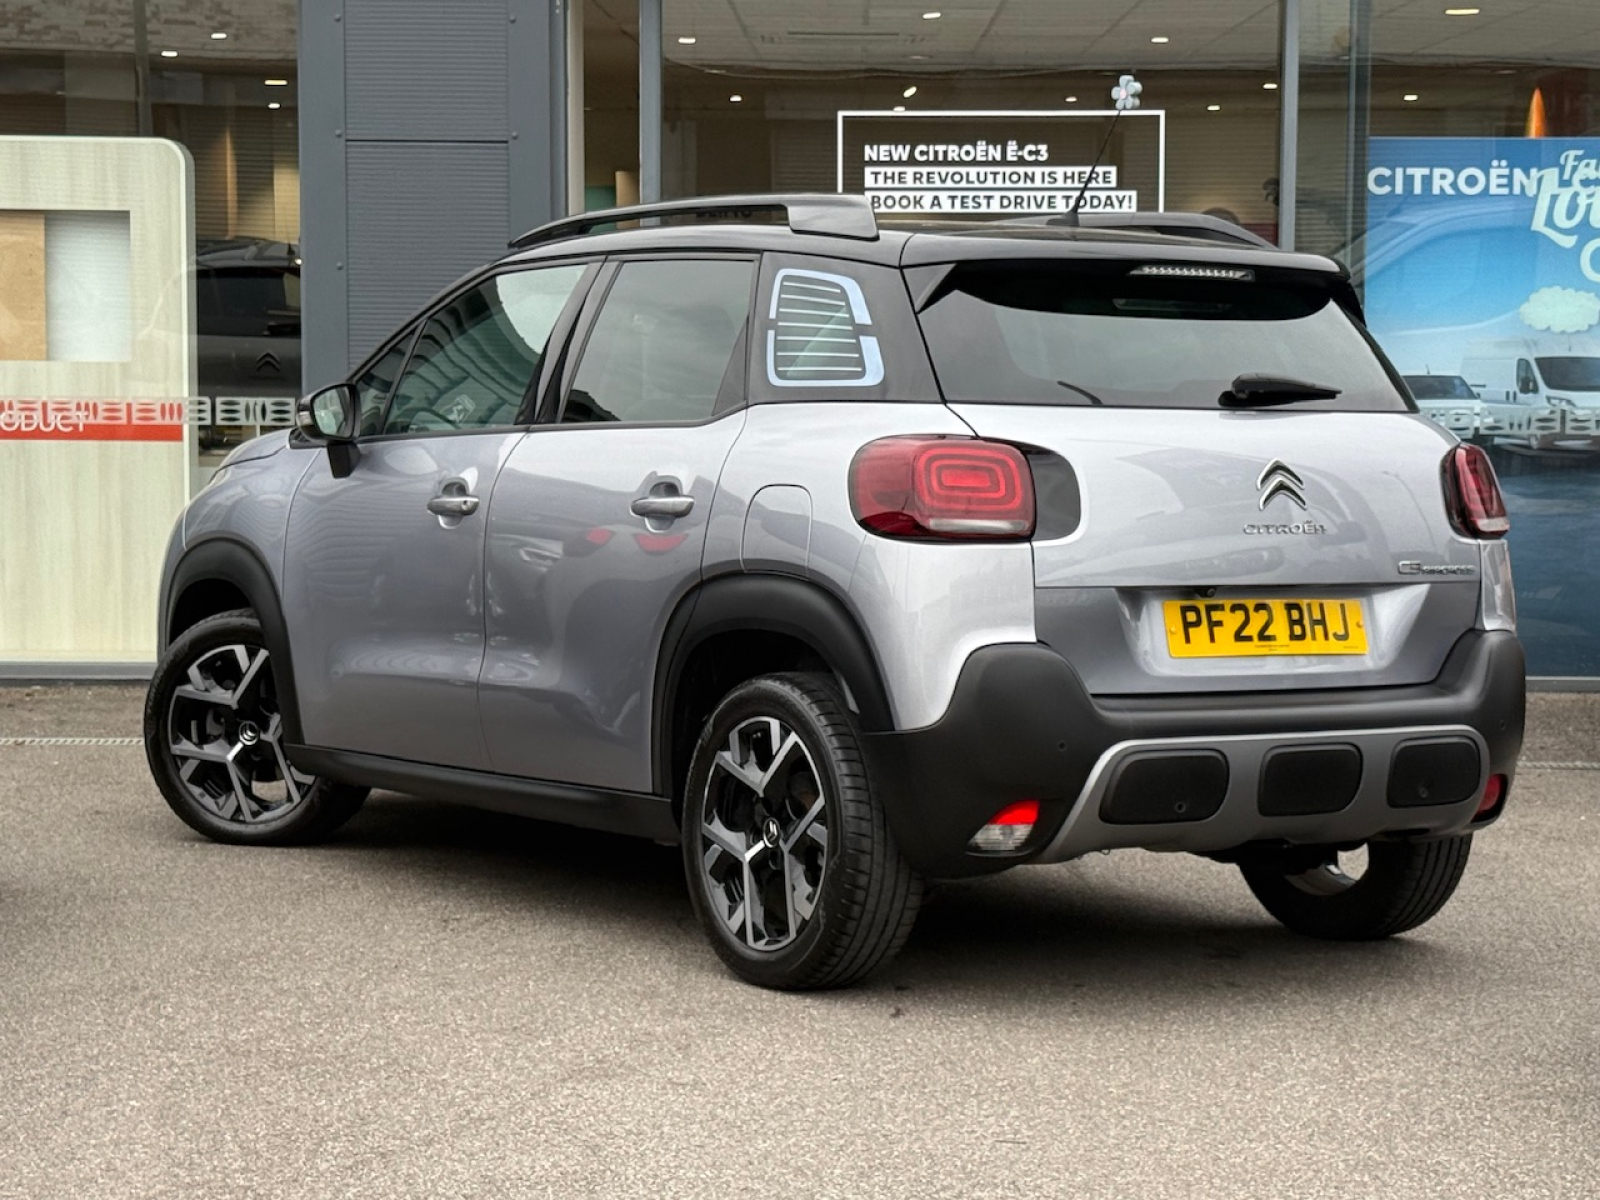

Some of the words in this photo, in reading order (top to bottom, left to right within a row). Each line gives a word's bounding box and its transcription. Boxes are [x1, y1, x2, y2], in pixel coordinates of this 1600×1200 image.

[864, 144, 911, 161] NEW
[914, 140, 1001, 161] CITROËN
[1006, 140, 1049, 161] Ë-C3
[870, 171, 907, 184] THE
[913, 171, 1035, 184] REVOLUTION
[1041, 171, 1057, 184] IS
[1063, 171, 1111, 184] HERE
[1367, 160, 1537, 195] CITROËN
[871, 195, 924, 209] BOOK
[930, 195, 942, 209] A
[948, 195, 995, 209] TEST
[1000, 195, 1056, 209] DRIVE
[1061, 195, 1132, 209] TODAY!
[1179, 602, 1277, 645] PF22
[1284, 602, 1350, 642] BHJ
